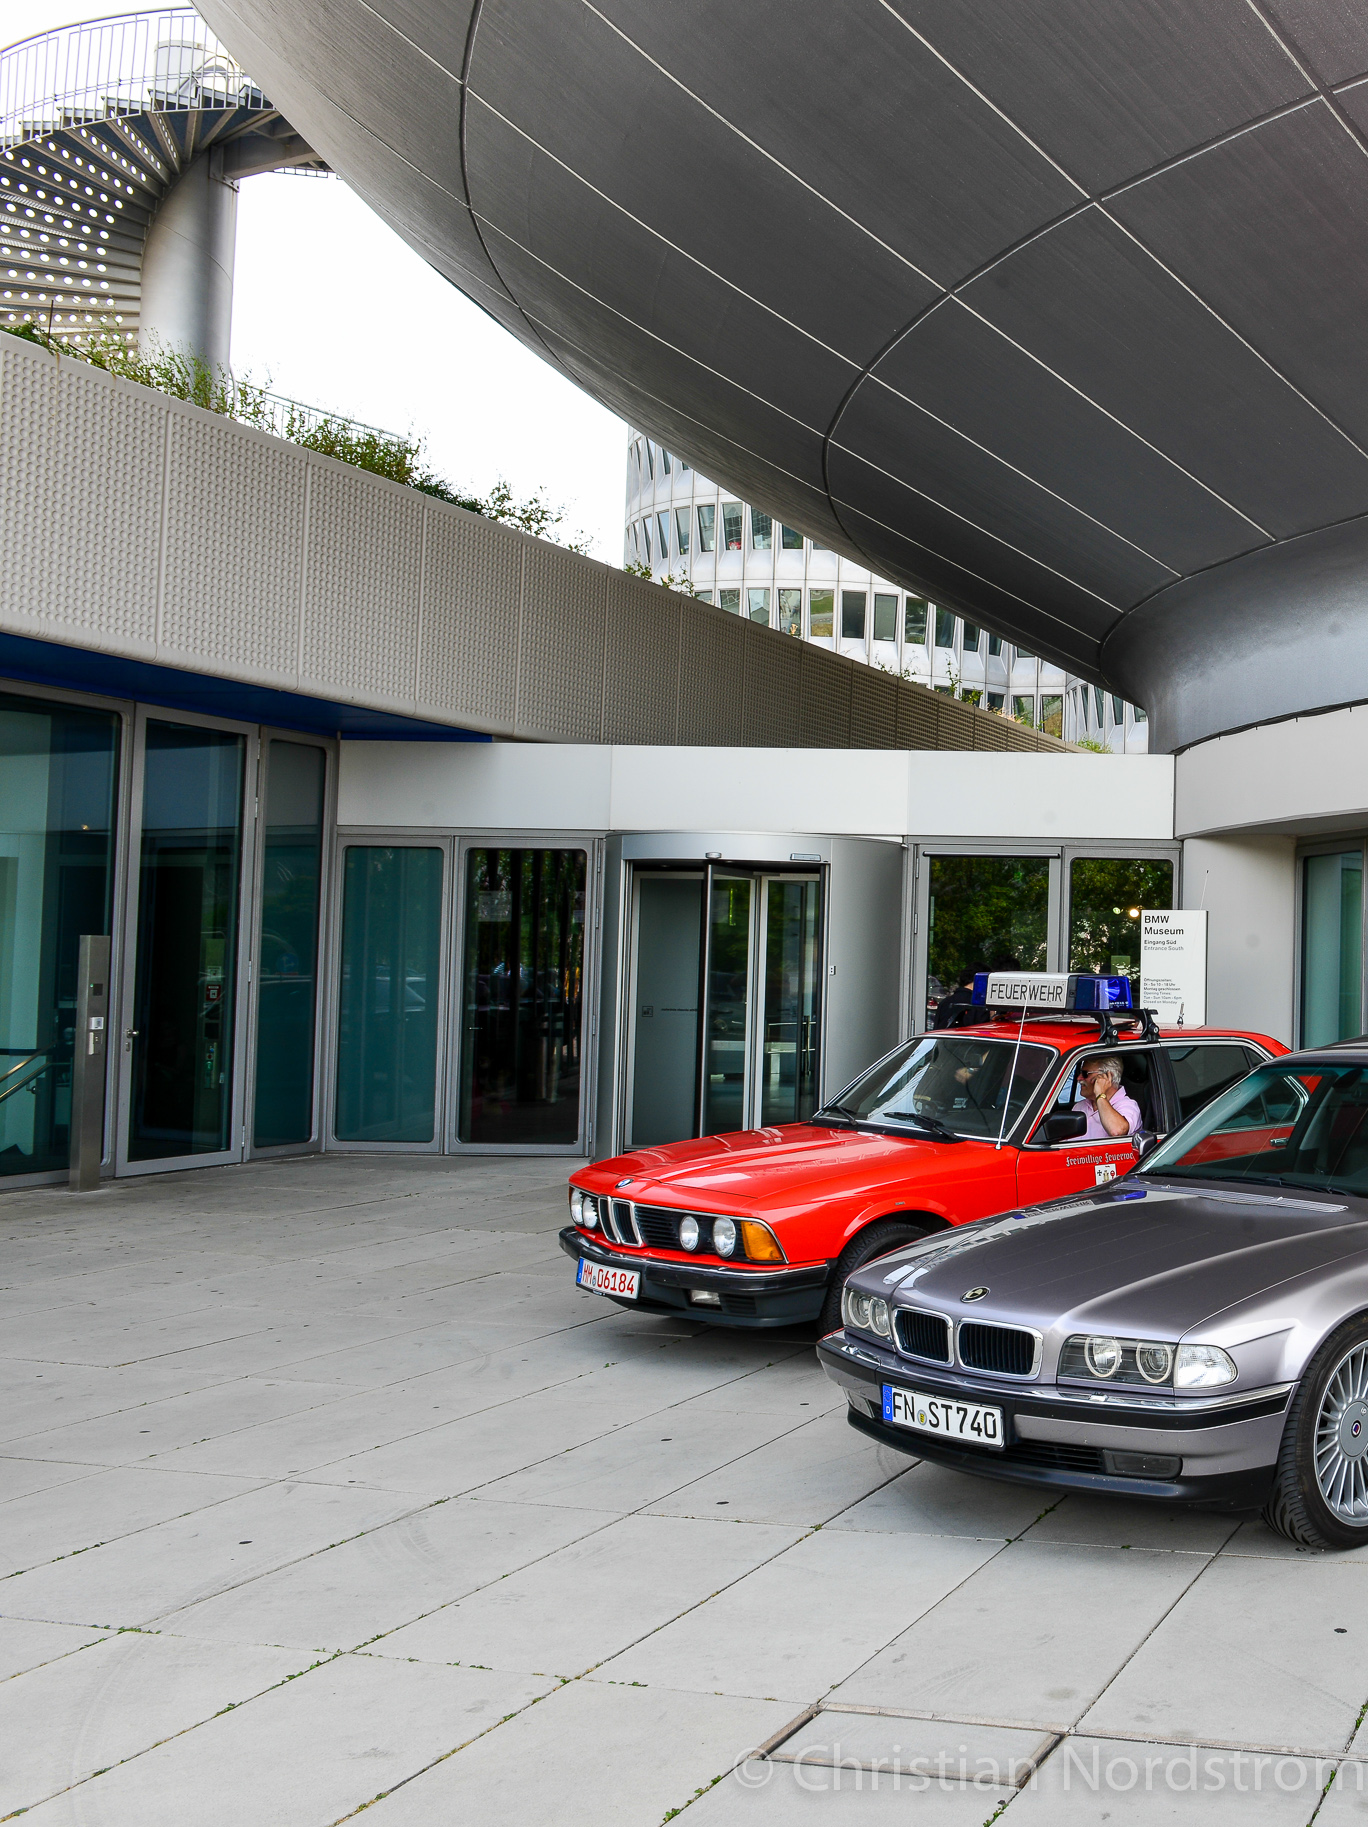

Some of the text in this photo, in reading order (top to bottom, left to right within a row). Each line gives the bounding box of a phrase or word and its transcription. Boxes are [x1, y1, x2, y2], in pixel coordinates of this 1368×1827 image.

[1144, 915, 1170, 924] BMW
[1144, 927, 1184, 935] Museum
[989, 983, 1063, 1002] FEUERWEHR
[1065, 1154, 1103, 1167] Freiwillige
[597, 1268, 635, 1294] 06184
[892, 1391, 915, 1423] FN
